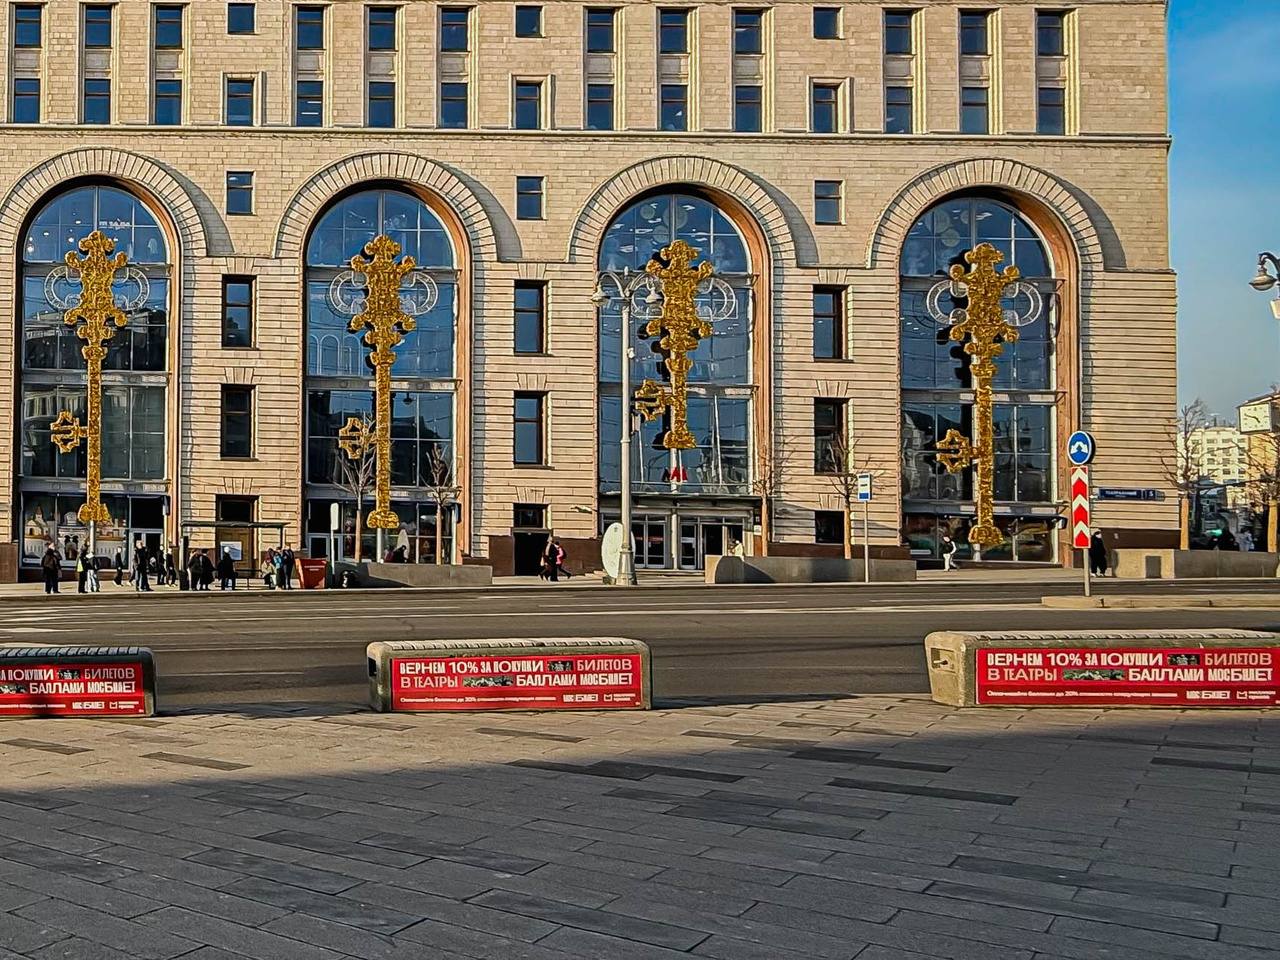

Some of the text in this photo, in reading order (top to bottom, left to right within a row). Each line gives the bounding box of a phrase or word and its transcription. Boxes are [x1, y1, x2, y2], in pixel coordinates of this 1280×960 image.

[987, 653, 1272, 666] ВЕРНЕМ 10% ЗА ПОКУПКИ БИЛЕТОВ
[399, 659, 632, 674] ВЕРНЕМ 10% ЗА ПОКУПКИ БИЛЕТОВ
[8, 669, 54, 681] ПОКУПКИ
[84, 667, 135, 679] БИЛЕТОВ
[988, 669, 1000, 680] В
[1004, 669, 1057, 681] ТЕАТРЫ
[1128, 669, 1204, 681] БАЛЛАМИ
[401, 677, 411, 688] В
[413, 677, 458, 688] ТЕАТРЫ
[516, 674, 577, 686] БАЛЛАМИ
[29, 683, 85, 694] БАЛЛАМИ
